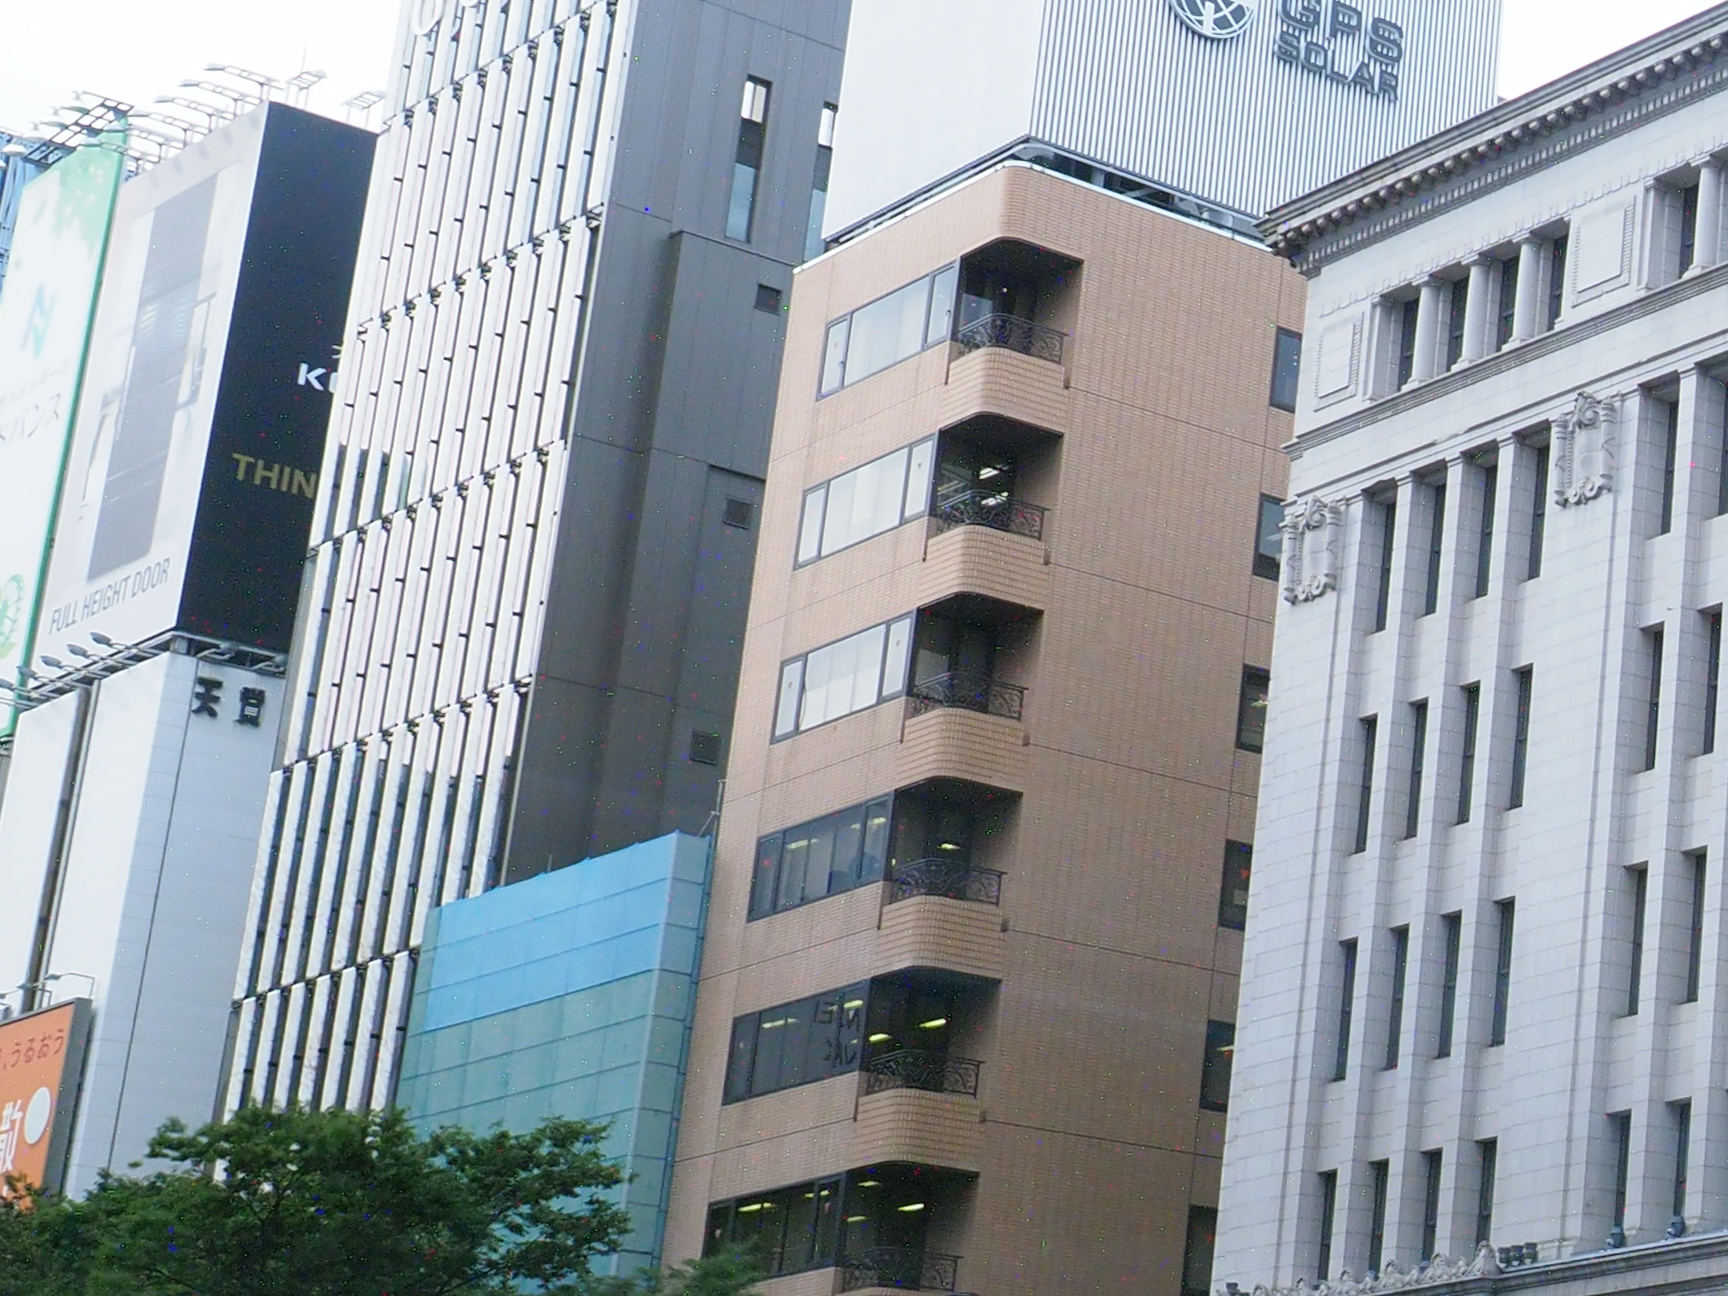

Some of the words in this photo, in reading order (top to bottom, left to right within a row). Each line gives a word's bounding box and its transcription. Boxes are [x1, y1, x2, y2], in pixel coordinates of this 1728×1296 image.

[1273, 27, 1400, 103] SOLAR
[48, 599, 78, 635] FULL
[80, 574, 132, 622] HEIGHT
[130, 557, 170, 599] DOOR
